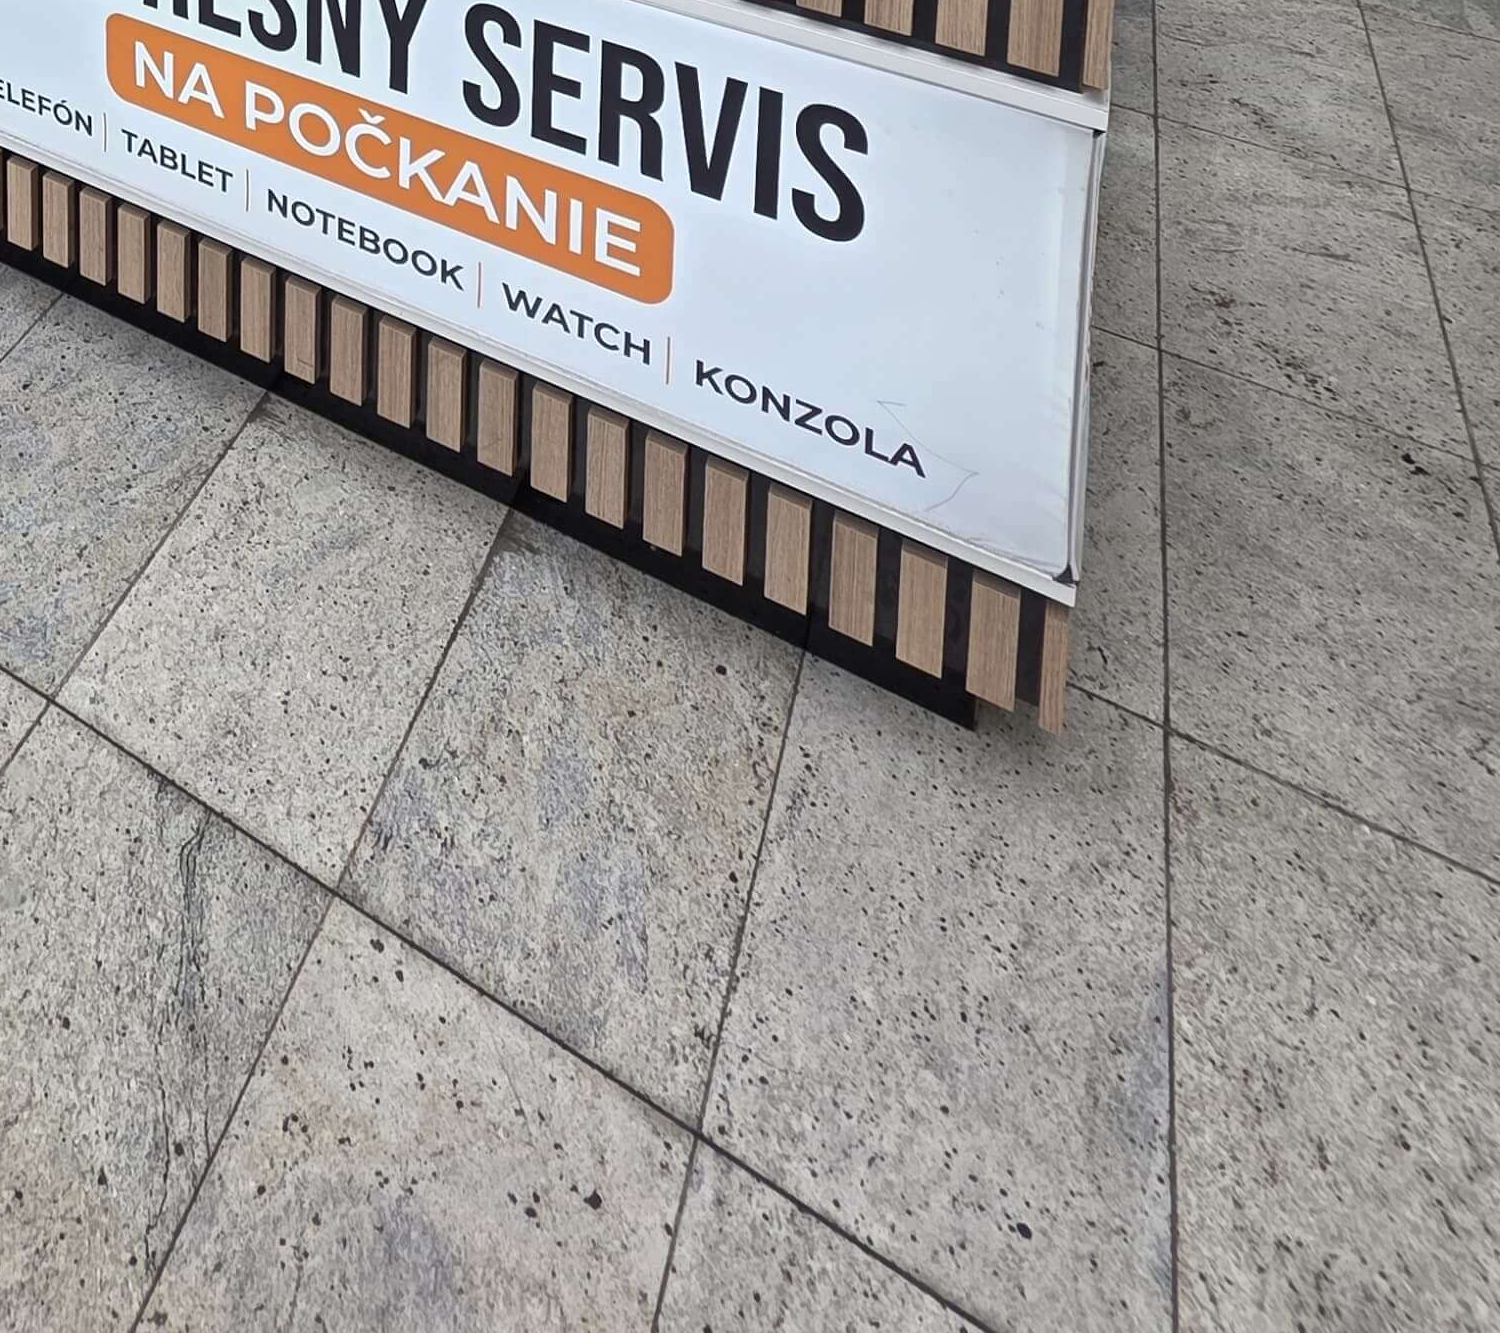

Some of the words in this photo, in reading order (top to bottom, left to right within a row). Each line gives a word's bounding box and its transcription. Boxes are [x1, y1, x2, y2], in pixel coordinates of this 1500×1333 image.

[134, 40, 224, 119] NA
[244, 84, 641, 277] POČKANIE
[462, 3, 868, 242] SERVIS
[121, 129, 233, 193] TABLET
[266, 188, 463, 290] NOTEBOOK
[502, 283, 651, 365] WATCH
[695, 359, 926, 478] KONZOLA
